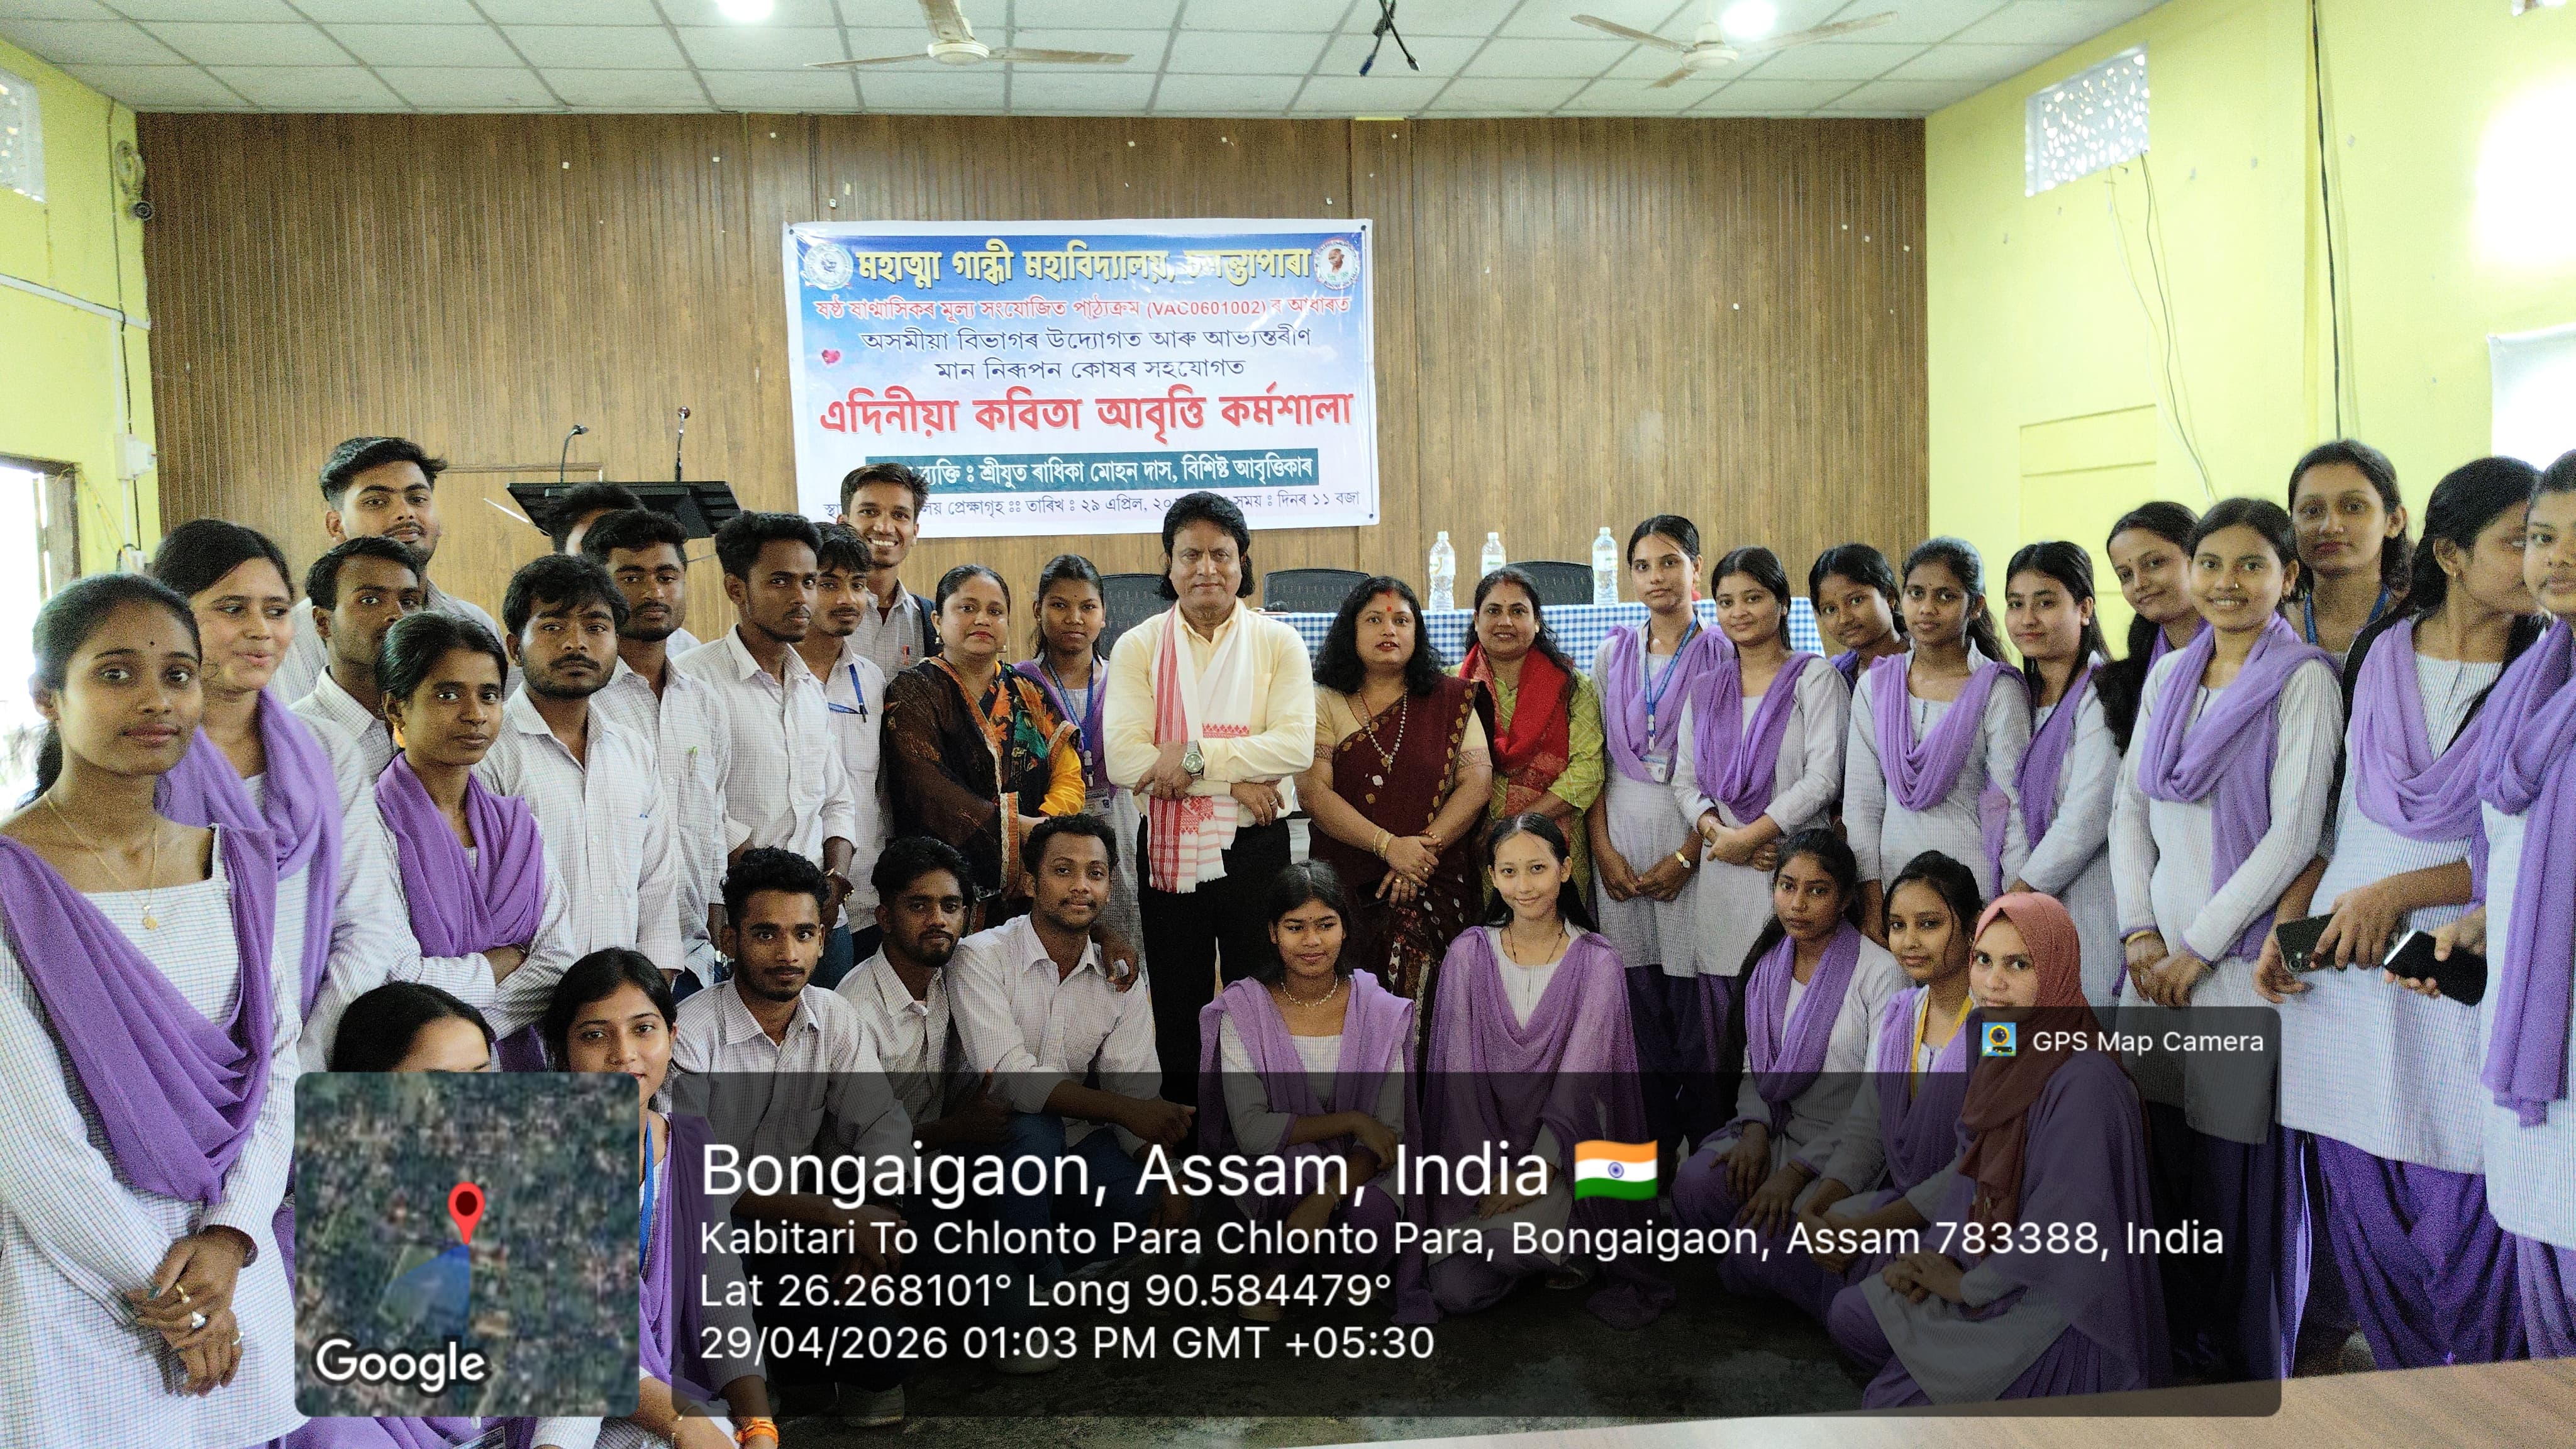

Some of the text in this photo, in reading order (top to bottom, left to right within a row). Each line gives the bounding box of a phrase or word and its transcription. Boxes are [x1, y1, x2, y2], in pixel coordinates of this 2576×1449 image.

[855, 251, 943, 289] মহাত্মা
[951, 239, 1015, 284] গান্ধী
[816, 295, 845, 317] ষষ্ঠ
[941, 300, 976, 323] মূল্য
[981, 296, 1066, 318] সংযোজিত
[1146, 300, 1265, 318] (VAC0601002)
[1272, 300, 1281, 313] ৰ
[1287, 296, 1350, 313] আধাৰত
[862, 328, 948, 350] অসমীয়া
[957, 328, 1040, 350] বিভাগৰ
[1046, 327, 1143, 350] উদ্যোগত
[1149, 330, 1197, 348] আৰু
[935, 363, 975, 379] মান
[1072, 362, 1137, 379] কোষৰ
[1143, 360, 1245, 379] সহযোগত
[820, 382, 1353, 445] এদিনীয়া কবিতা আবৃত্তি কৰ্মশালা
[1031, 457, 1084, 483] ৰাধিকা
[1091, 462, 1138, 482] মোহন
[1143, 459, 1177, 483] দাস,
[1182, 454, 1230, 482] বিশিষ্ট
[1233, 452, 1313, 484] আবৃত্তিকাৰ
[1026, 496, 1064, 514] তাৰিখ
[1082, 501, 1101, 513] ২৯
[1233, 496, 1262, 508] সময়
[1278, 491, 1306, 508] দিনৰ
[1313, 494, 1330, 506] ১১
[1335, 491, 1360, 506] বজা
